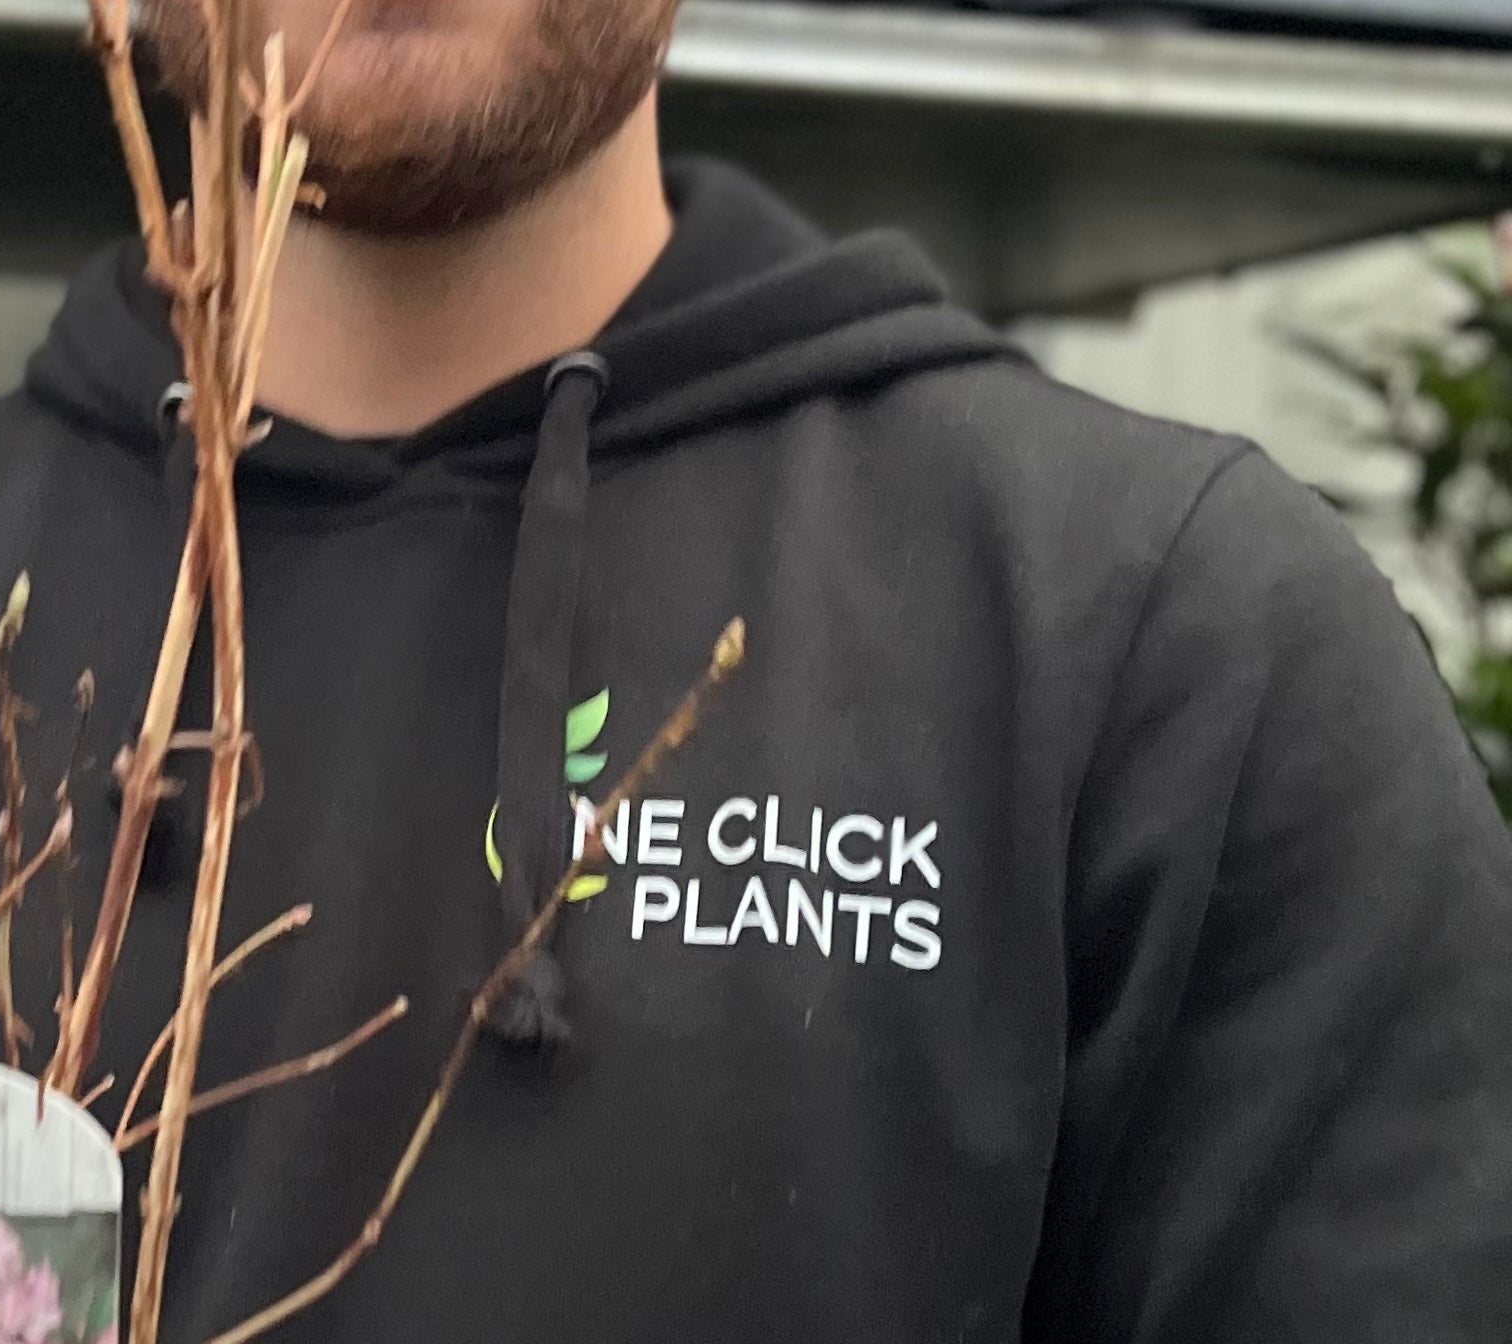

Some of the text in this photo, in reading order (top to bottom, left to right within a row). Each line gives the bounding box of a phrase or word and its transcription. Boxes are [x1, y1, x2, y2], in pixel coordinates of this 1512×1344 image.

[487, 794, 941, 889] NE CLICK
[631, 874, 943, 971] PLANTS
